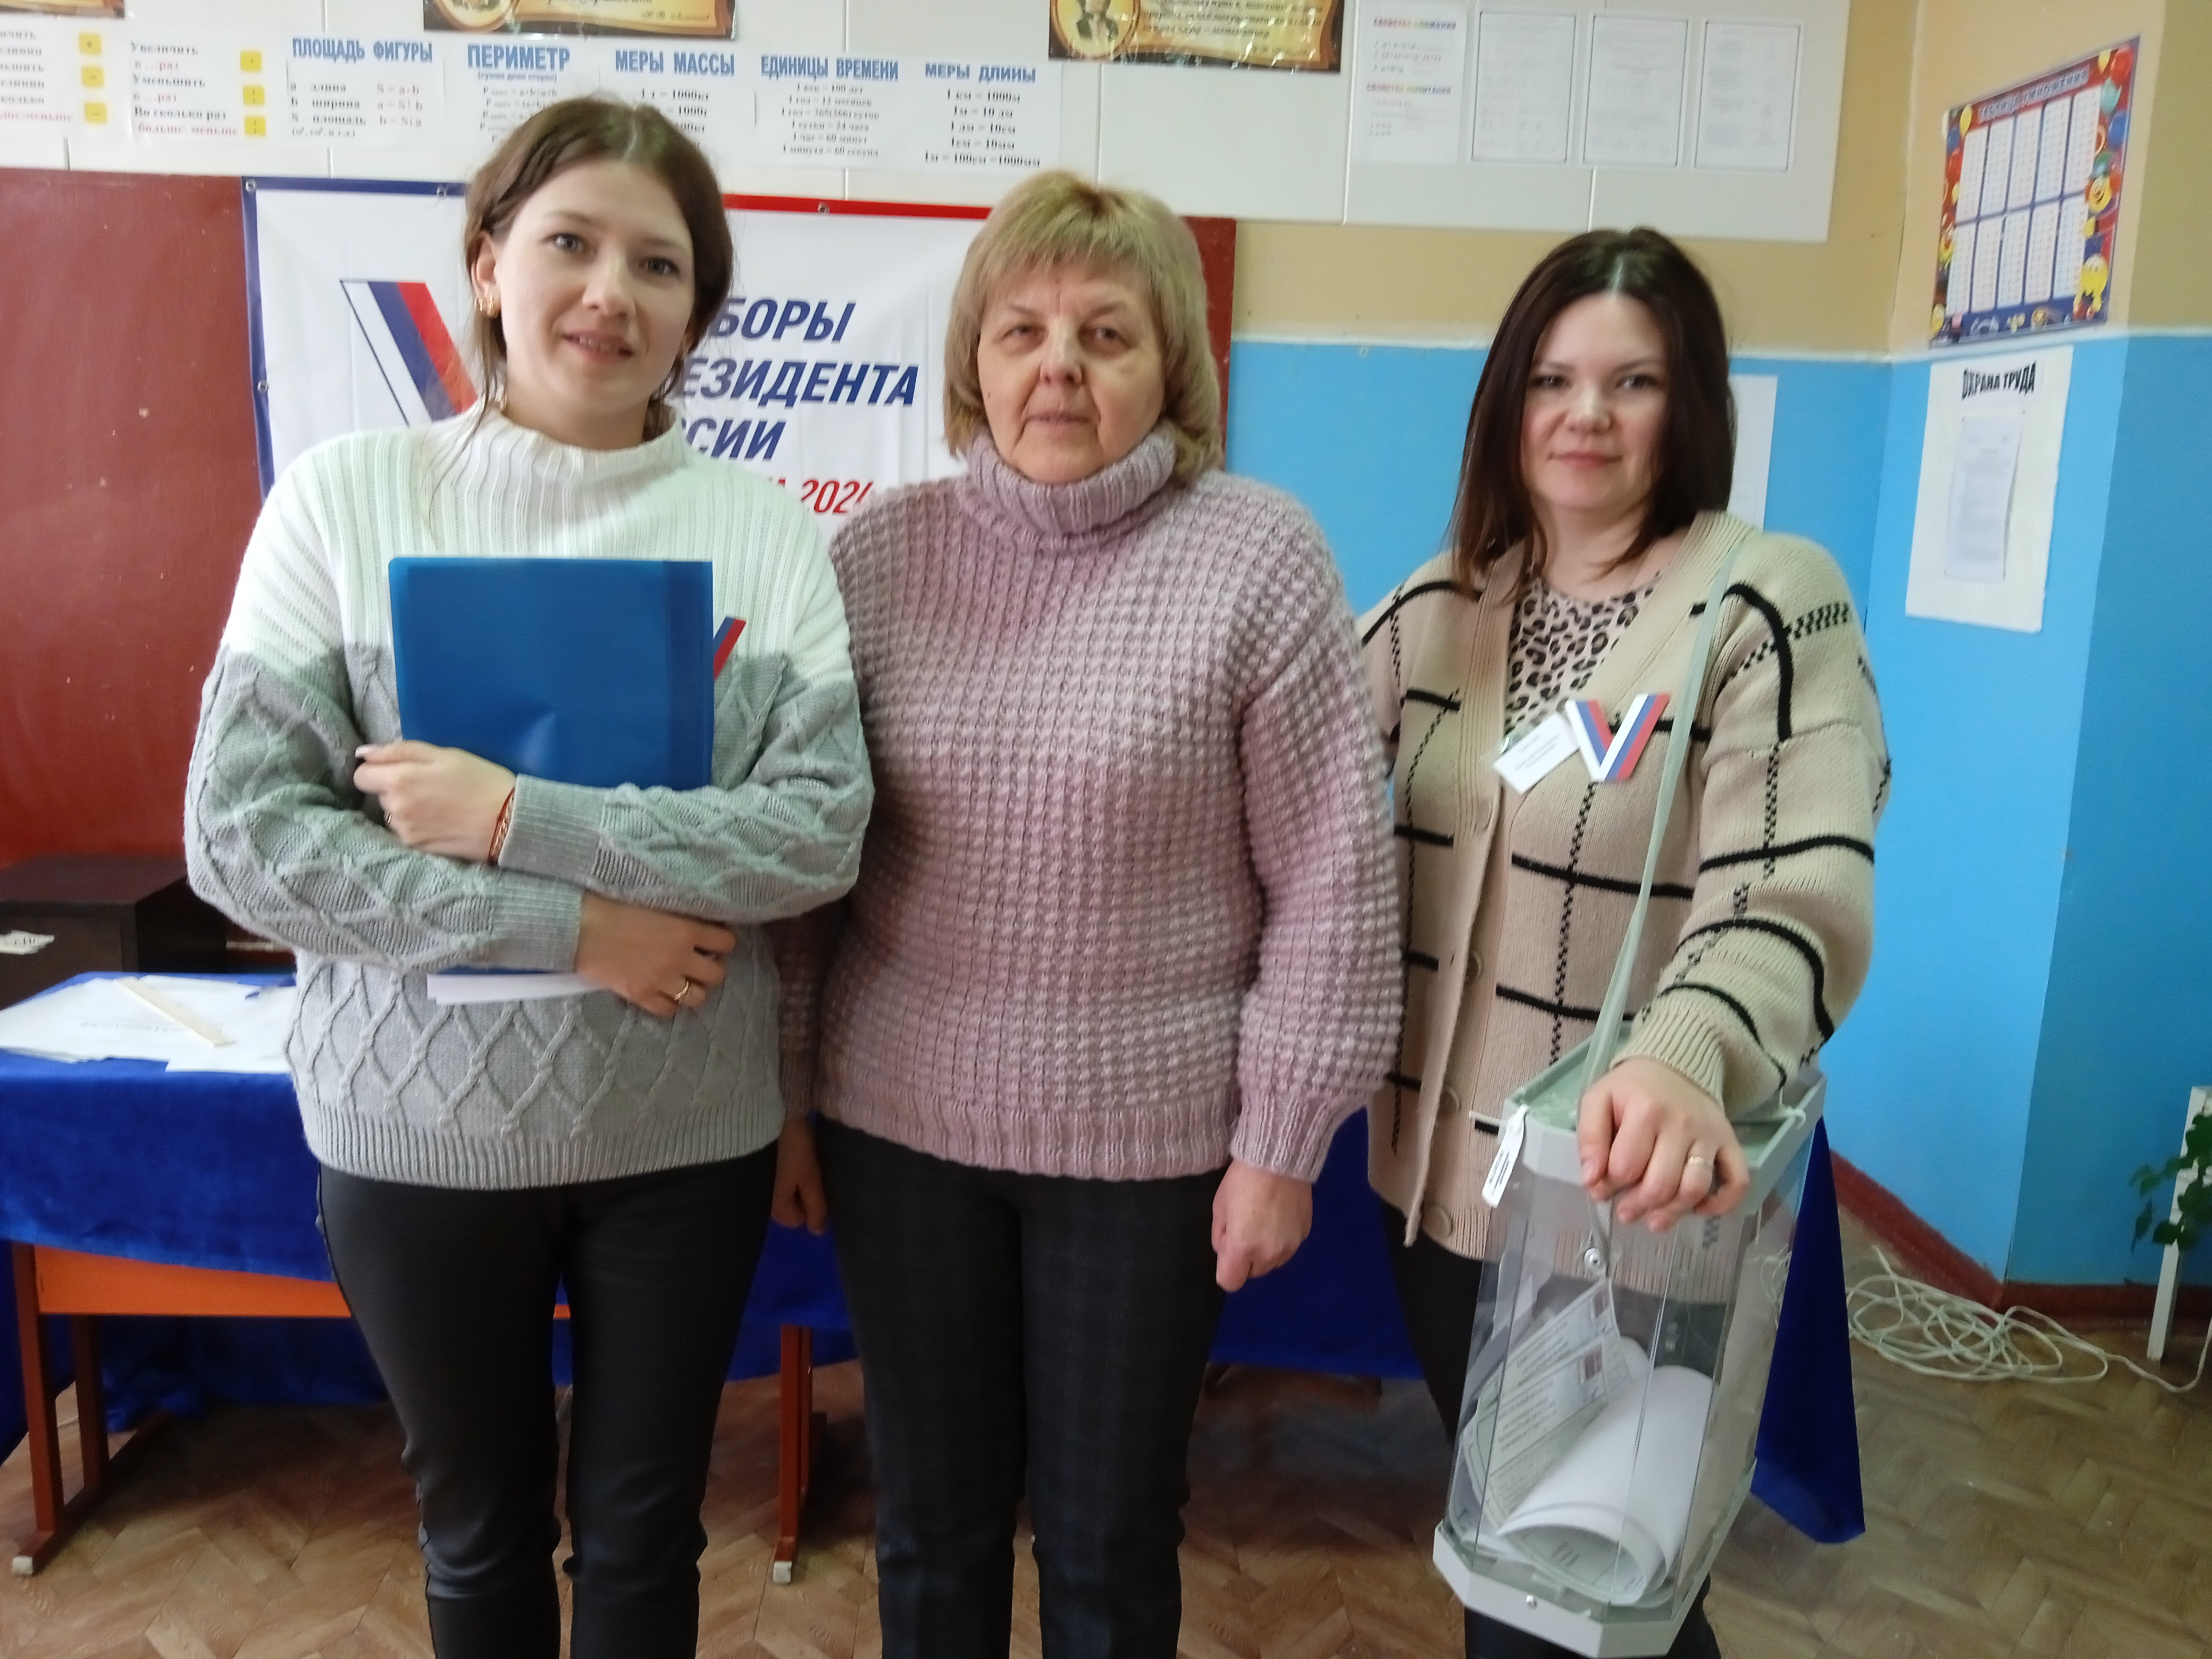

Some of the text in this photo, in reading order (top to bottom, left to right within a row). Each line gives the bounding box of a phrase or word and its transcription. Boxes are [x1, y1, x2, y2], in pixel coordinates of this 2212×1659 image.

[292, 38, 432, 64] ПЛОЩАДЬ ФИГУРЫ
[468, 45, 571, 72] ПЕРИМЕТР
[615, 49, 735, 77] МЕРЫ МАССЫ
[761, 56, 898, 82] ЕДИНИЦЫ ВРЕМЕНИ
[925, 62, 1036, 84] МЕРЫ ДЛИНЫ
[987, 90, 1020, 104] 1000м
[984, 106, 995, 118] 10
[1962, 360, 2037, 401] ОХРАНА ТРУДА
[682, 417, 786, 462] СИИ
